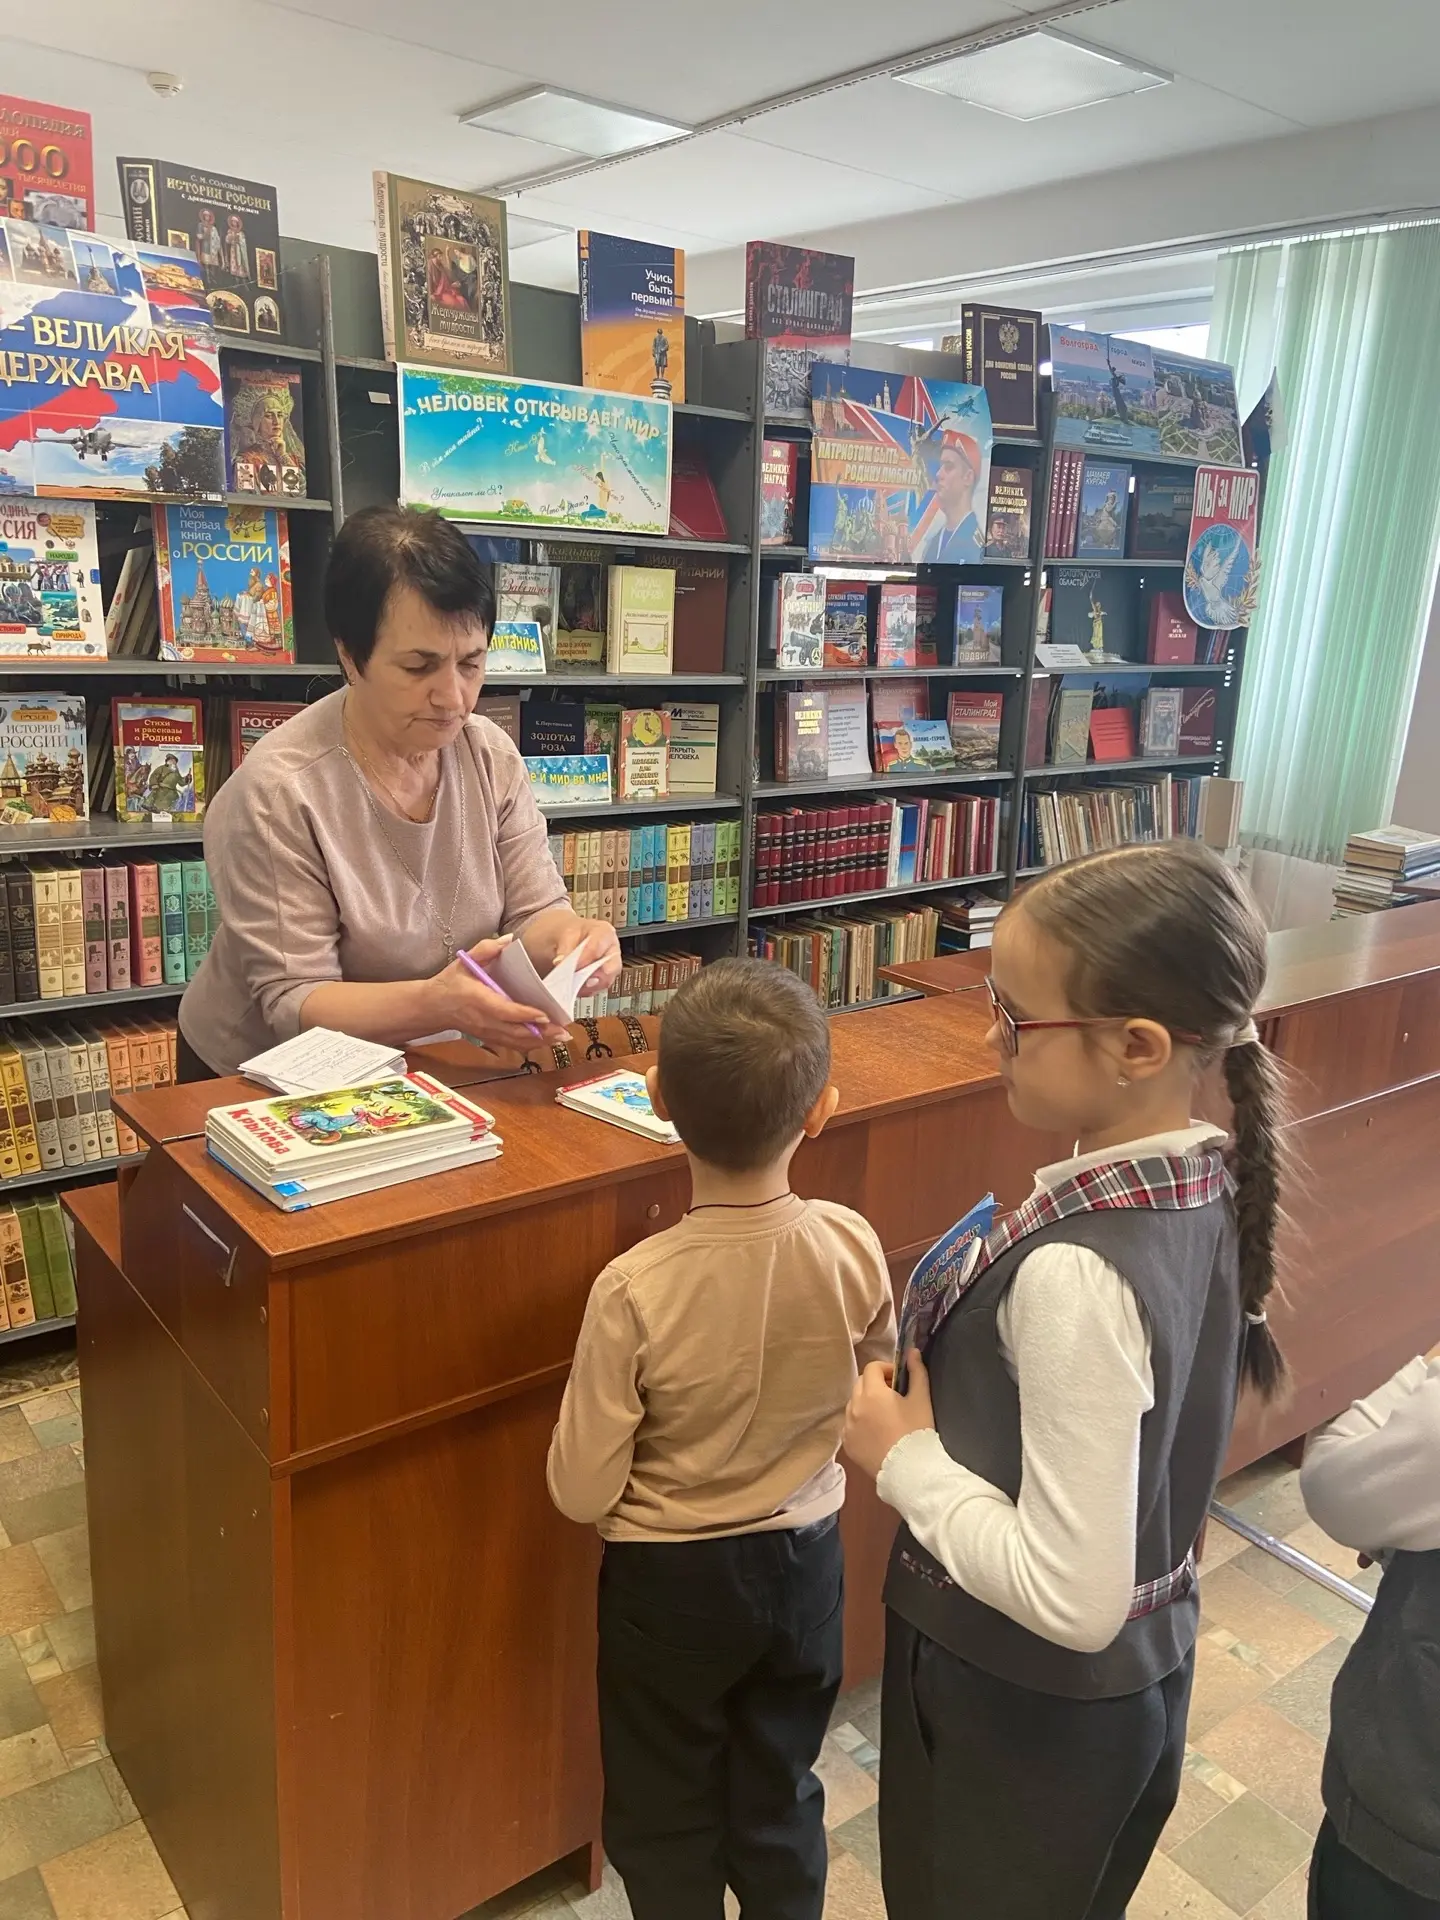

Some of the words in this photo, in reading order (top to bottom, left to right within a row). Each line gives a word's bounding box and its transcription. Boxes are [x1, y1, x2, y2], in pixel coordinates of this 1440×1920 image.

[645, 268, 673, 284] Учись
[648, 281, 673, 296] быть
[631, 291, 673, 307] первым!
[767, 283, 843, 326] СТАЛИНГРАД
[31, 315, 187, 362] ВЕЛИКАЯ
[1060, 336, 1099, 352] Волгоград
[417, 393, 509, 413] ЧЕЛОВЕК
[514, 398, 623, 428] ОТКРЫВАЕТ
[624, 416, 662, 441] МИР
[818, 441, 872, 462] ПАТРИОТОМ
[873, 445, 899, 465] БЫТЬ
[763, 473, 788, 487] НАГРАД
[844, 464, 881, 483] РОДИНУ
[1085, 478, 1107, 486] КУРГАН
[1196, 473, 1219, 518] МЫ
[1218, 478, 1229, 508] ЗА
[1228, 475, 1256, 520] МИР
[180, 506, 205, 519] Моя
[181, 519, 221, 531] первая
[181, 531, 213, 541] книга
[182, 541, 273, 563] РОССИИ
[960, 651, 989, 661] ПОДВИГ
[983, 699, 998, 708] Мой
[954, 709, 997, 718] СТАЛИНГРАД
[6, 724, 61, 734] ИСТОРИЯ
[144, 719, 171, 727] Стихи
[241, 716, 289, 729] РОСС
[141, 726, 183, 735] рассказы
[530, 732, 577, 742] ЗОЛОТАЯ
[0, 735, 69, 749] РОССИИ
[141, 733, 182, 743] Родине
[541, 743, 566, 752] РОЗА
[550, 774, 570, 787] мир
[574, 775, 586, 785] во
[588, 771, 608, 785] мне
